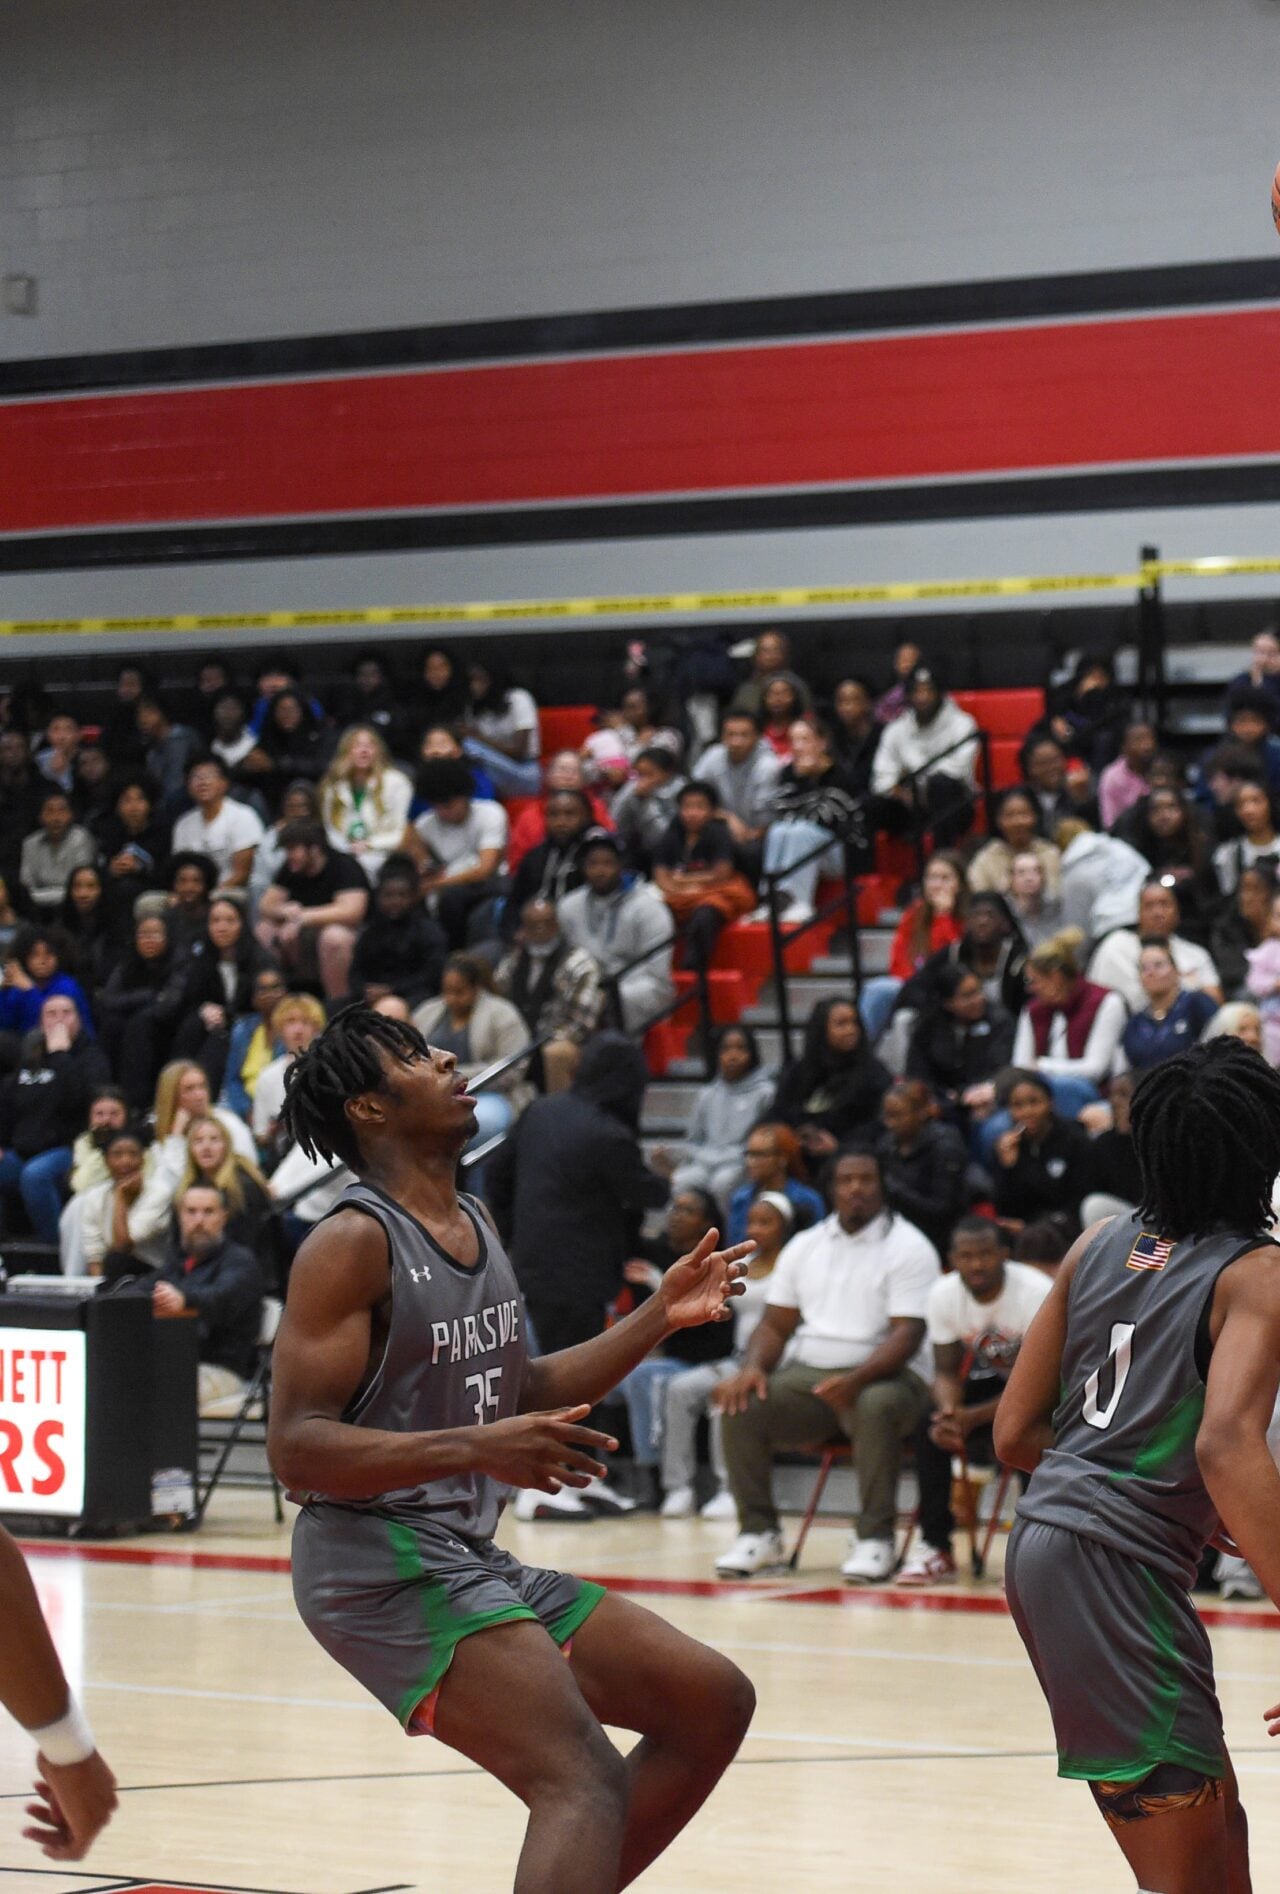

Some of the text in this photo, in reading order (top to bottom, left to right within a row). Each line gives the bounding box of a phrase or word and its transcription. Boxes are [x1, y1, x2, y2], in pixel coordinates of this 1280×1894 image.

[429, 1298, 520, 1366] PARKSIDE
[464, 1366, 503, 1426] 35
[1081, 1320, 1136, 1431] 0
